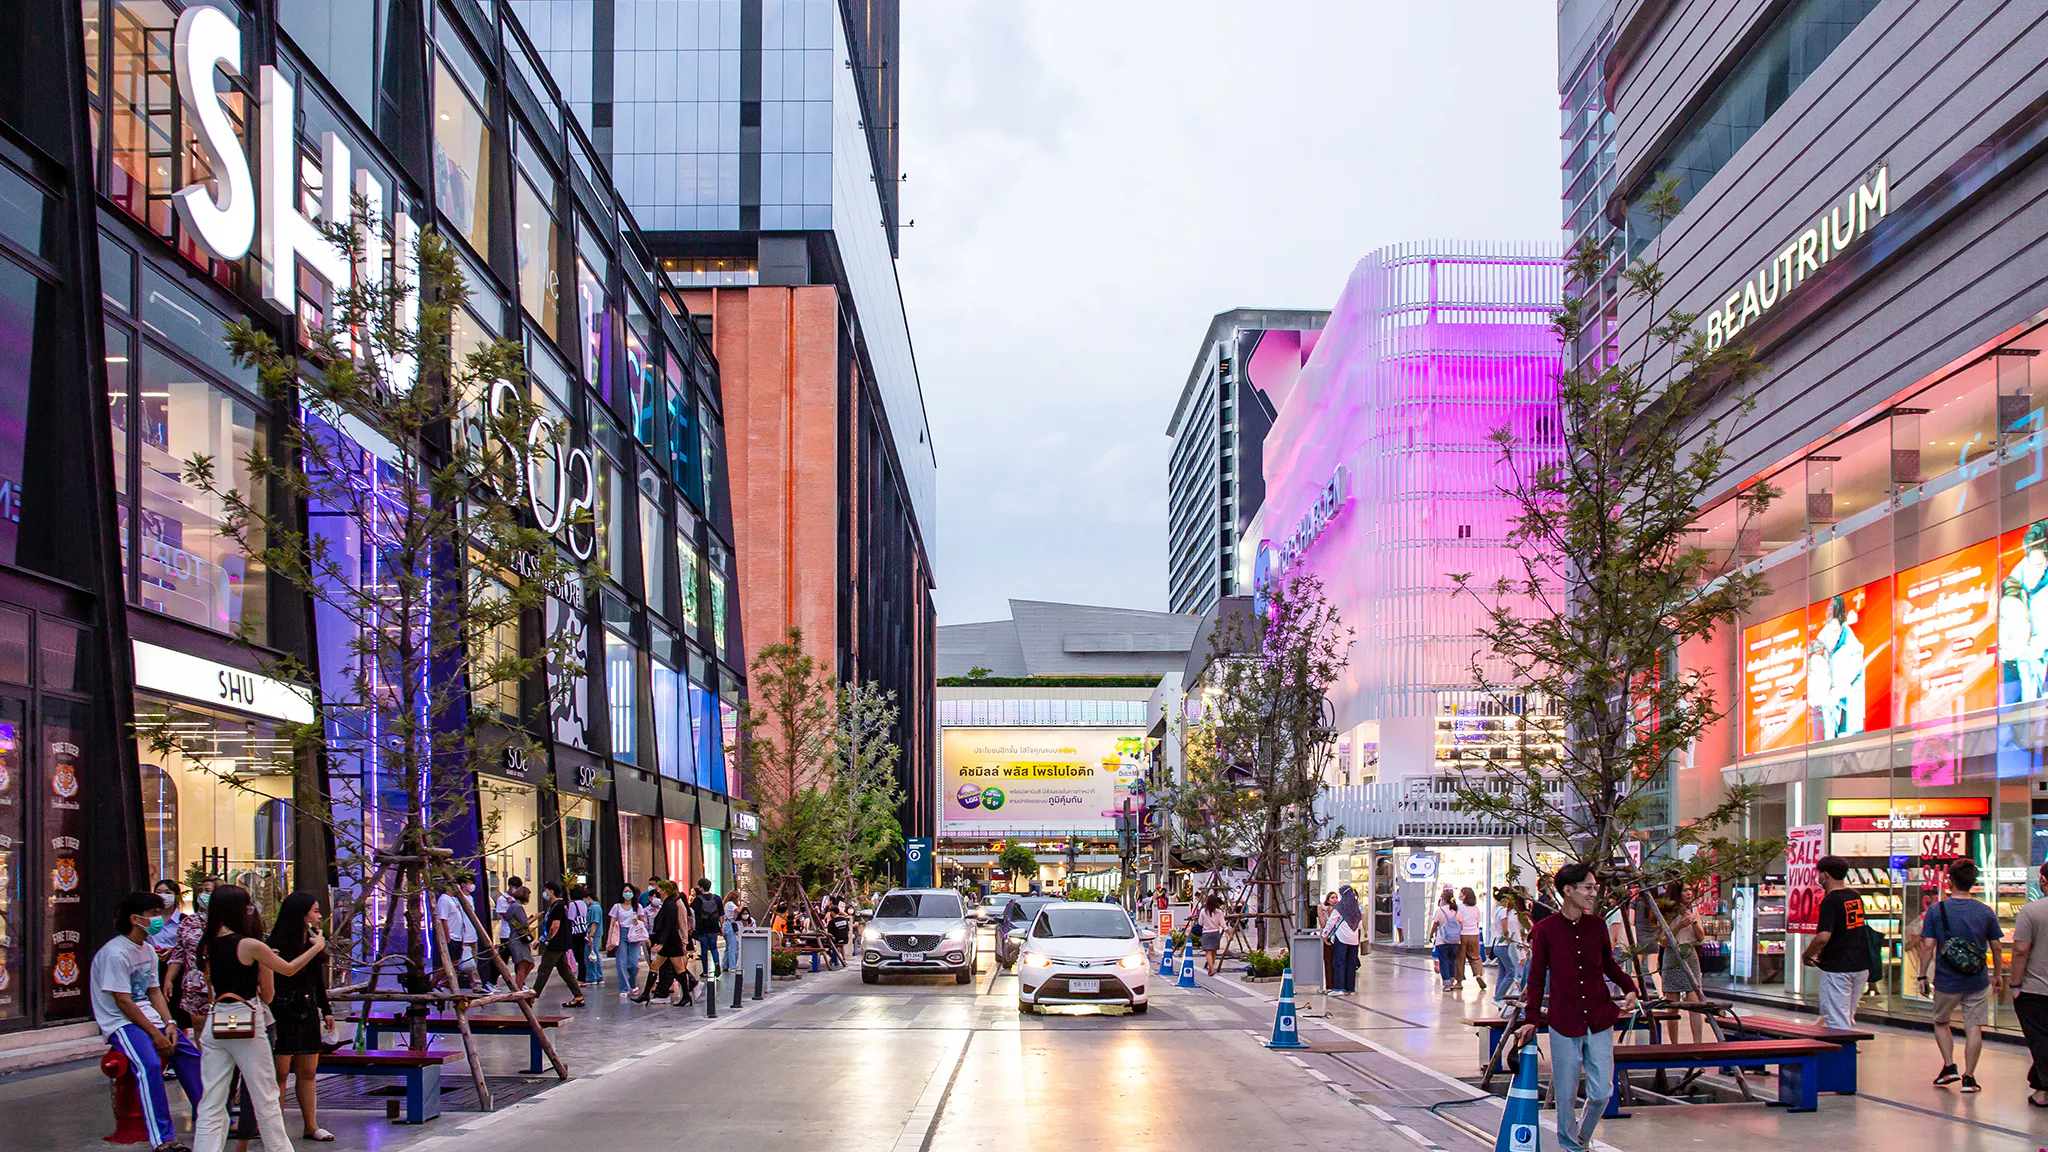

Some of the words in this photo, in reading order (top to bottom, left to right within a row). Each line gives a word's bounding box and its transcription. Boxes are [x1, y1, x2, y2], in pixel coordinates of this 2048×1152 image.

[171, 5, 420, 395] SHU
[1707, 166, 1888, 355] BEAUTRIUM
[218, 670, 254, 705] SHU
[959, 765, 999, 777] ดัชมิลล์
[1003, 765, 1028, 777] พลัส
[1033, 765, 1094, 777] โพรไบโอติก
[1048, 796, 1083, 806] ภูมิคุ้มกัน
[1911, 819, 1945, 829] HOUSE
[1787, 839, 1822, 865] SALE
[1921, 833, 1961, 860] SALE
[1921, 864, 1951, 891] SAL
